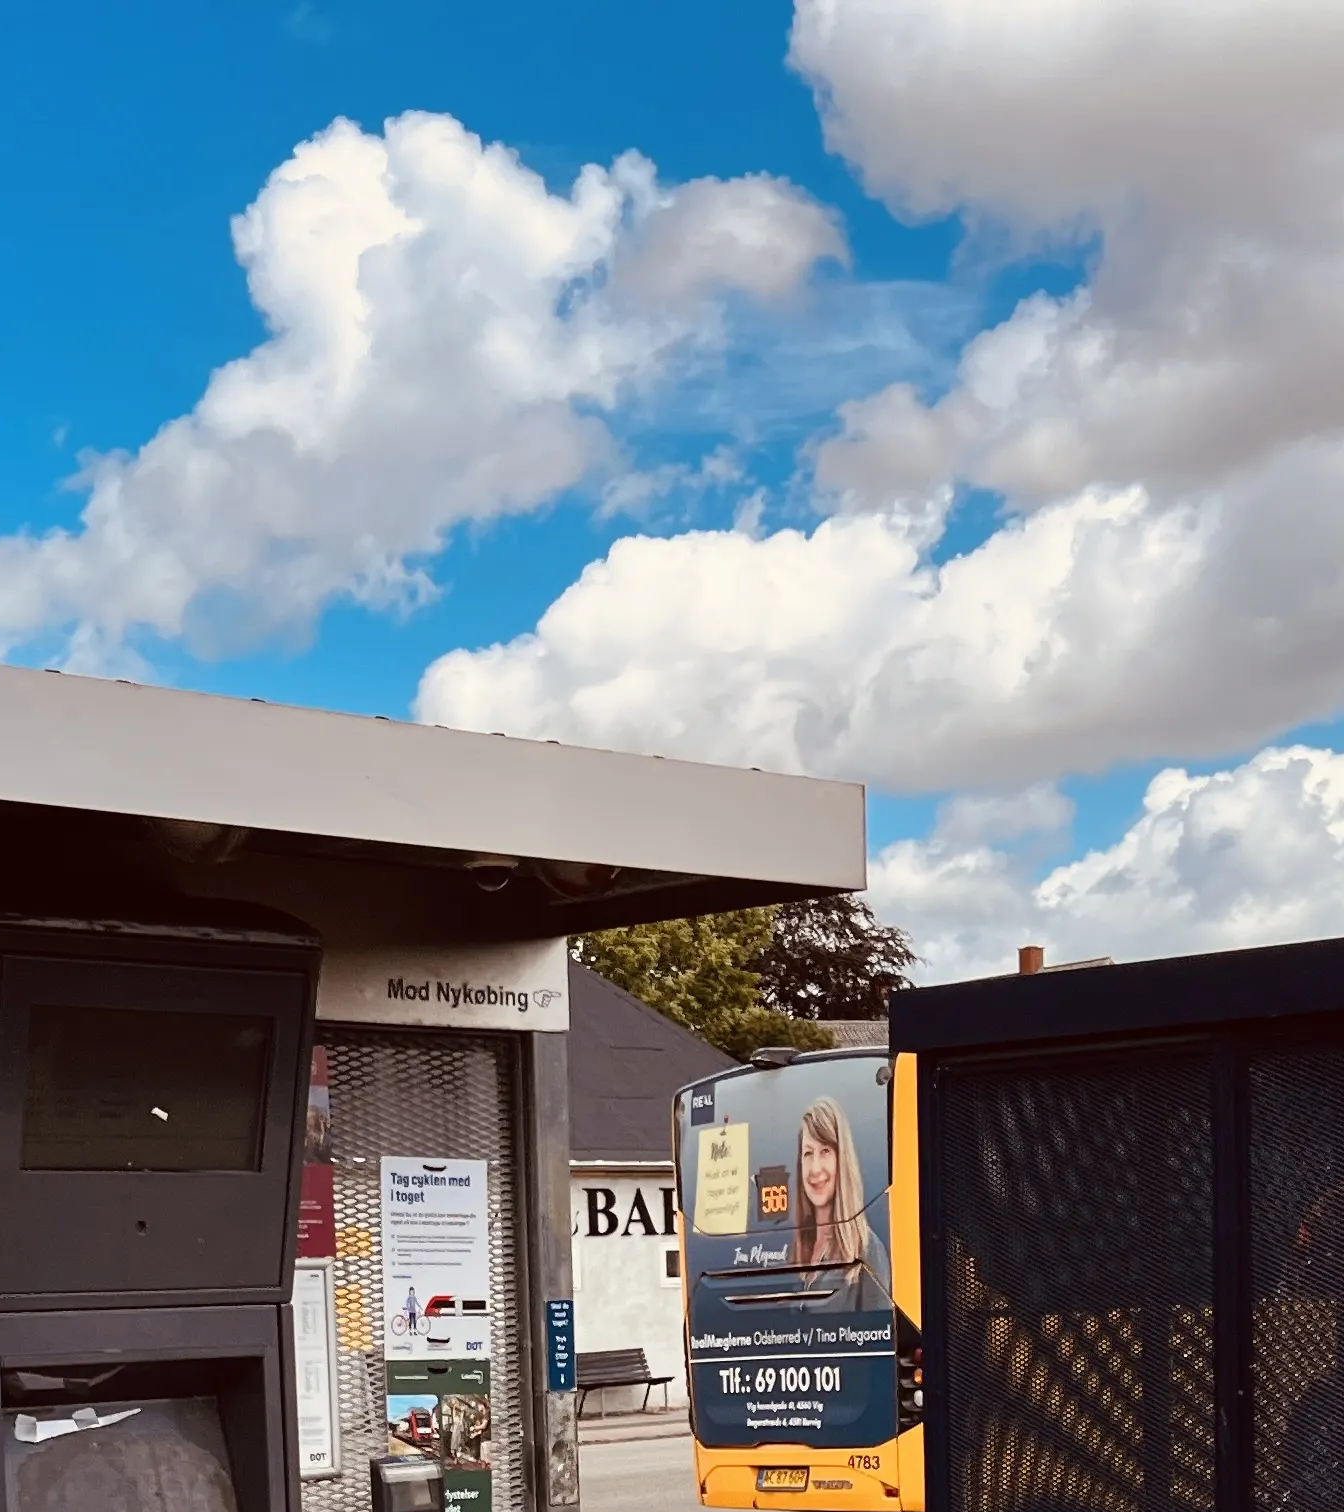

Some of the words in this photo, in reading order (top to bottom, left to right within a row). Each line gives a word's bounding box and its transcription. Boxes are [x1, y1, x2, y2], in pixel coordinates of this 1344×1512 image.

[387, 977, 430, 1002] Mod
[437, 981, 529, 1012] Nykøbing
[390, 1172, 409, 1188] Tag
[411, 1174, 447, 1188] cyklen
[448, 1175, 471, 1187] med
[390, 1189, 394, 1202] i
[396, 1190, 425, 1205] toget
[761, 1185, 788, 1214] 566
[753, 1328, 801, 1346] Odsherred
[803, 1327, 814, 1346] v/
[816, 1327, 836, 1342] Tina
[839, 1324, 891, 1345] Pilegaard
[466, 1341, 483, 1351] DOT
[719, 1367, 751, 1394] Tlf.:
[755, 1368, 776, 1393] 69
[780, 1367, 811, 1392] 100
[814, 1366, 841, 1392] 101
[309, 1453, 327, 1462] DOT
[848, 1455, 880, 1470] 4783
